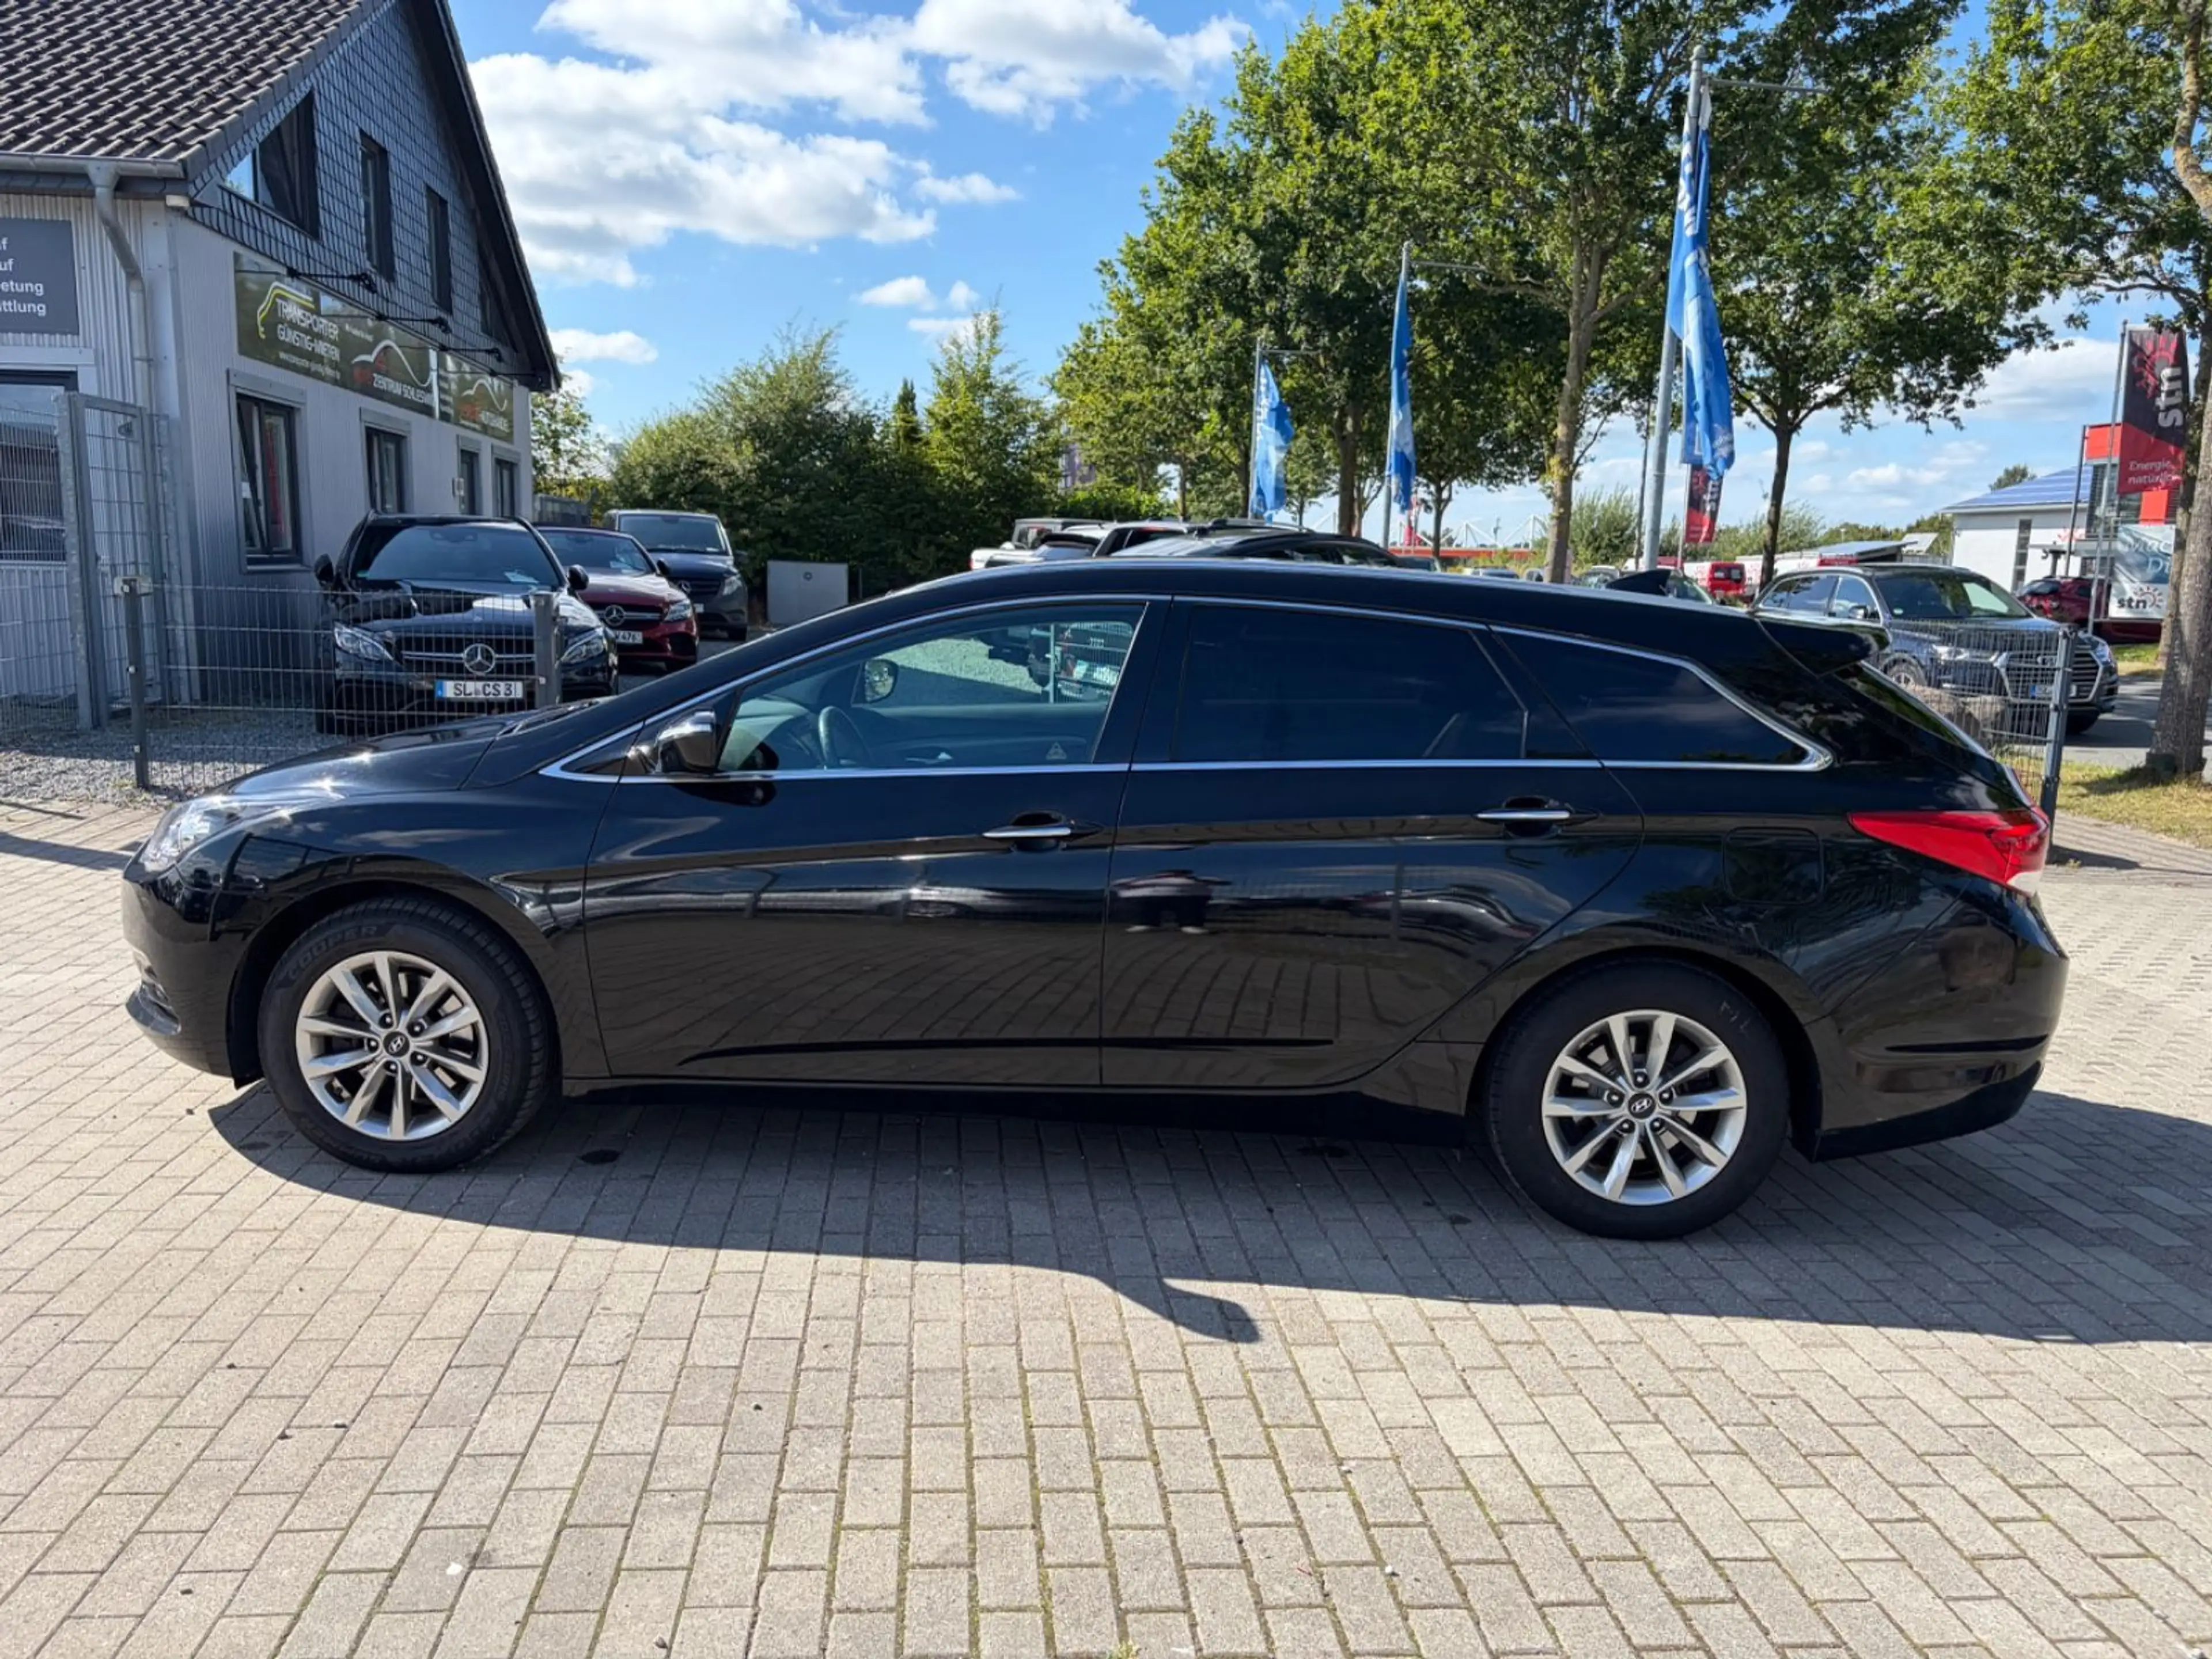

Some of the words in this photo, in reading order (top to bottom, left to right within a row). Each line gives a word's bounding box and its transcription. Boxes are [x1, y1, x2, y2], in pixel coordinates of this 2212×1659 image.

[0, 299, 46, 316] ttlung
[2156, 367, 2183, 427] stn
[2118, 597, 2147, 609] stn
[453, 683, 472, 696] SL
[482, 683, 501, 696] CS
[504, 683, 513, 696] 3
